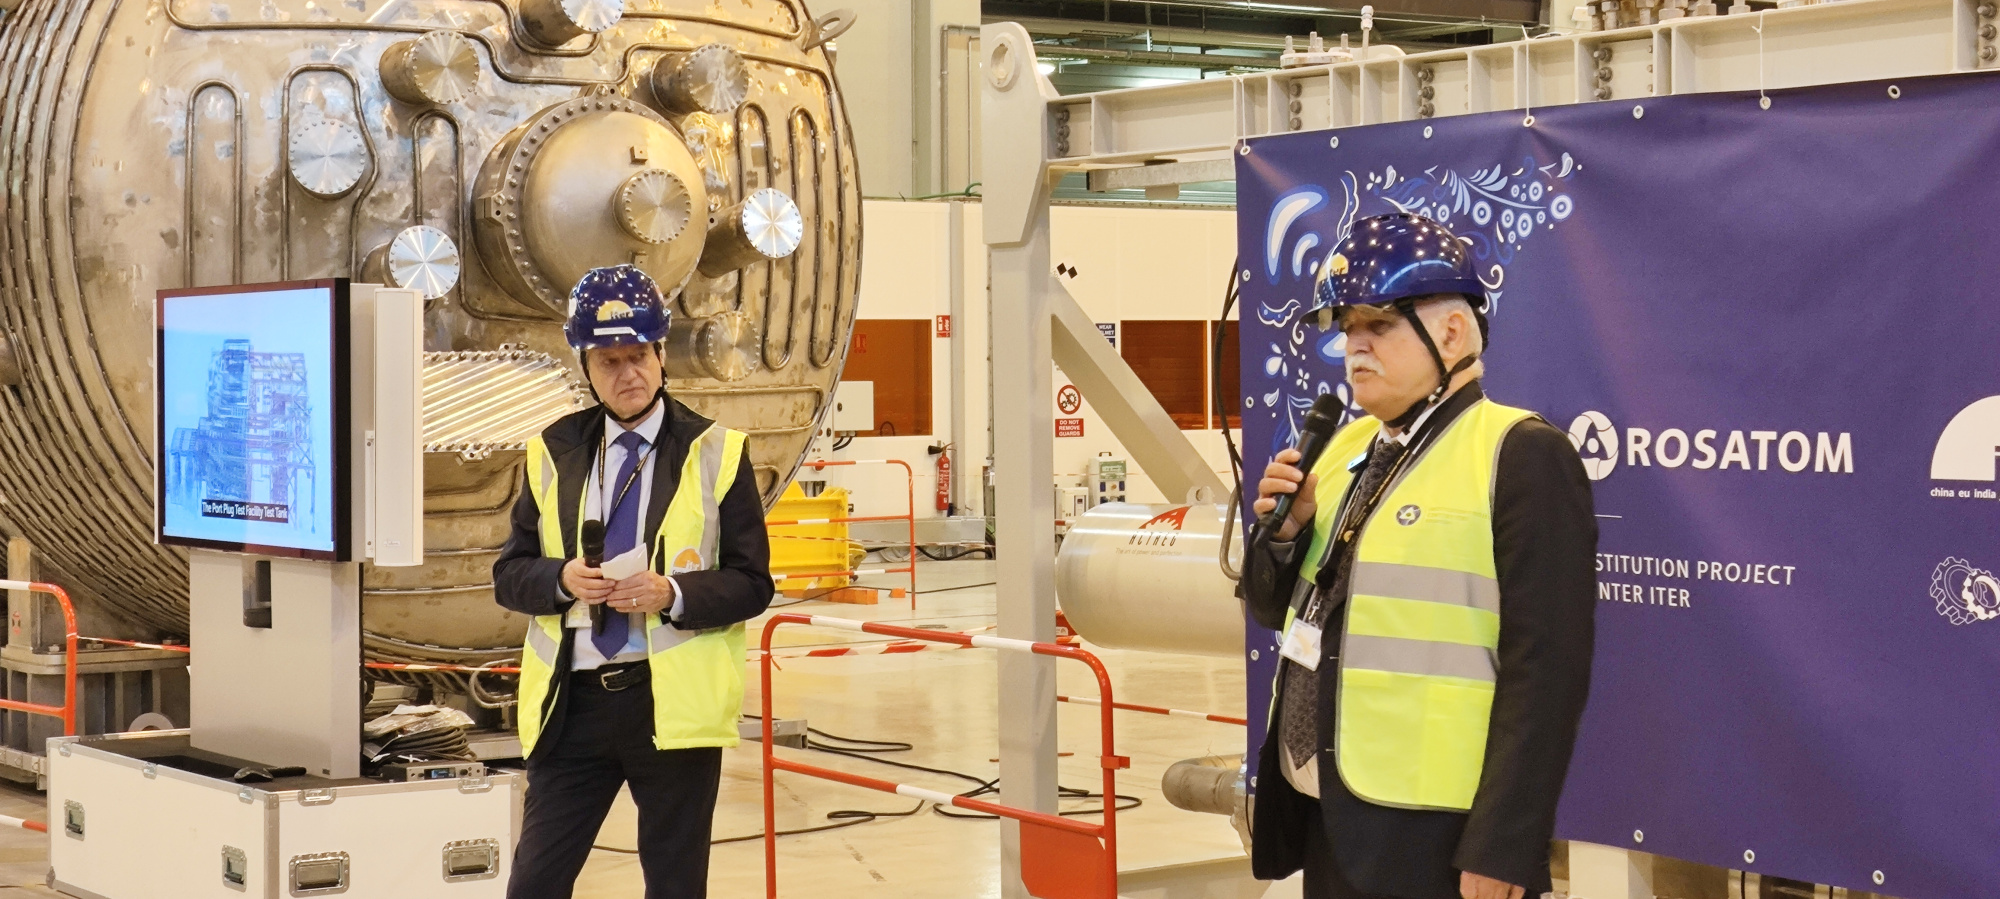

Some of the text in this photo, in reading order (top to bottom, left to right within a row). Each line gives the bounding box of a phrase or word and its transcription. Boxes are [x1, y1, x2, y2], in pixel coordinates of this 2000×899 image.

[1627, 428, 1853, 473] ROSATOM
[1930, 487, 1997, 498] china eu india
[202, 502, 288, 519] The Port Plug Test Facility Test Tank
[1595, 553, 1796, 585] STITUTION PROJECT
[1598, 582, 1691, 608] NTER ITER
